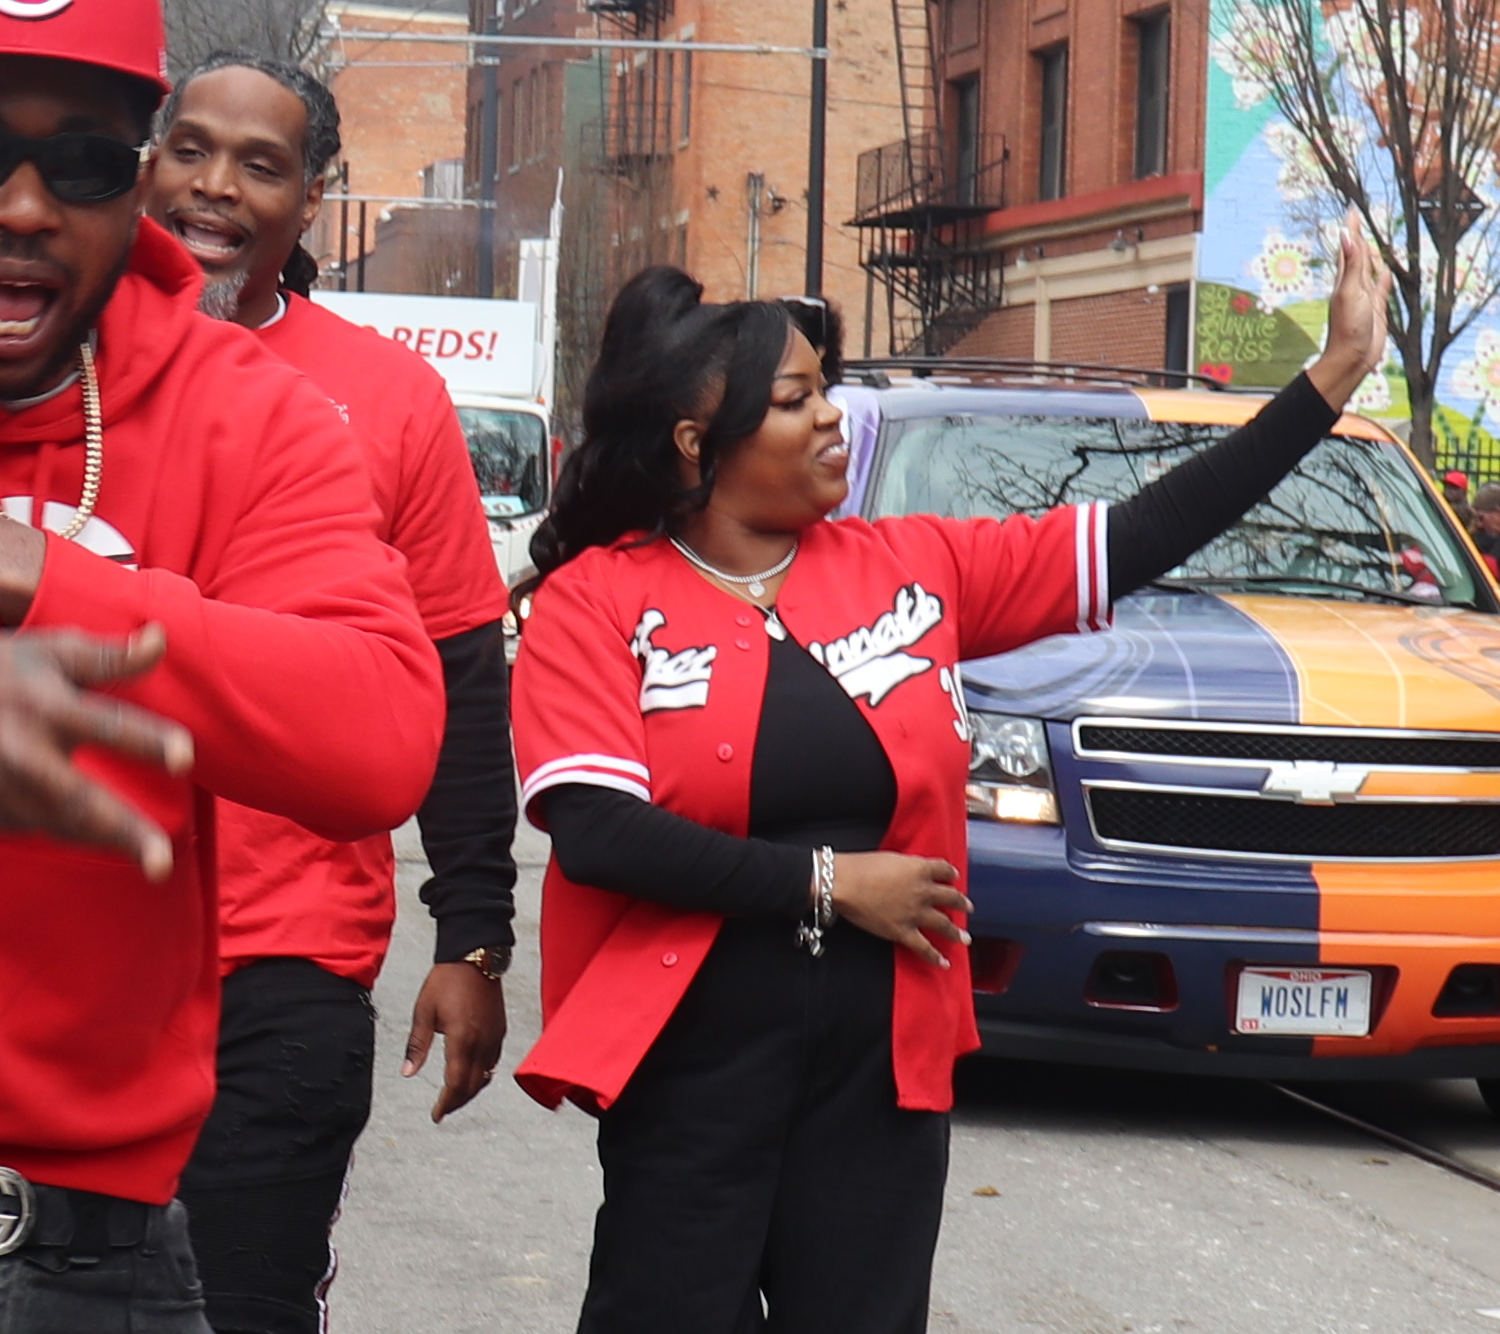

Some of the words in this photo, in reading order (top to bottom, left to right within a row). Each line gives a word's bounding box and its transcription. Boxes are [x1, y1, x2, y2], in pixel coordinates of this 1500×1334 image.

[392, 327, 499, 361] REDS!
[1289, 970, 1323, 983] OHIO
[1261, 985, 1349, 1018] WOSLFM
